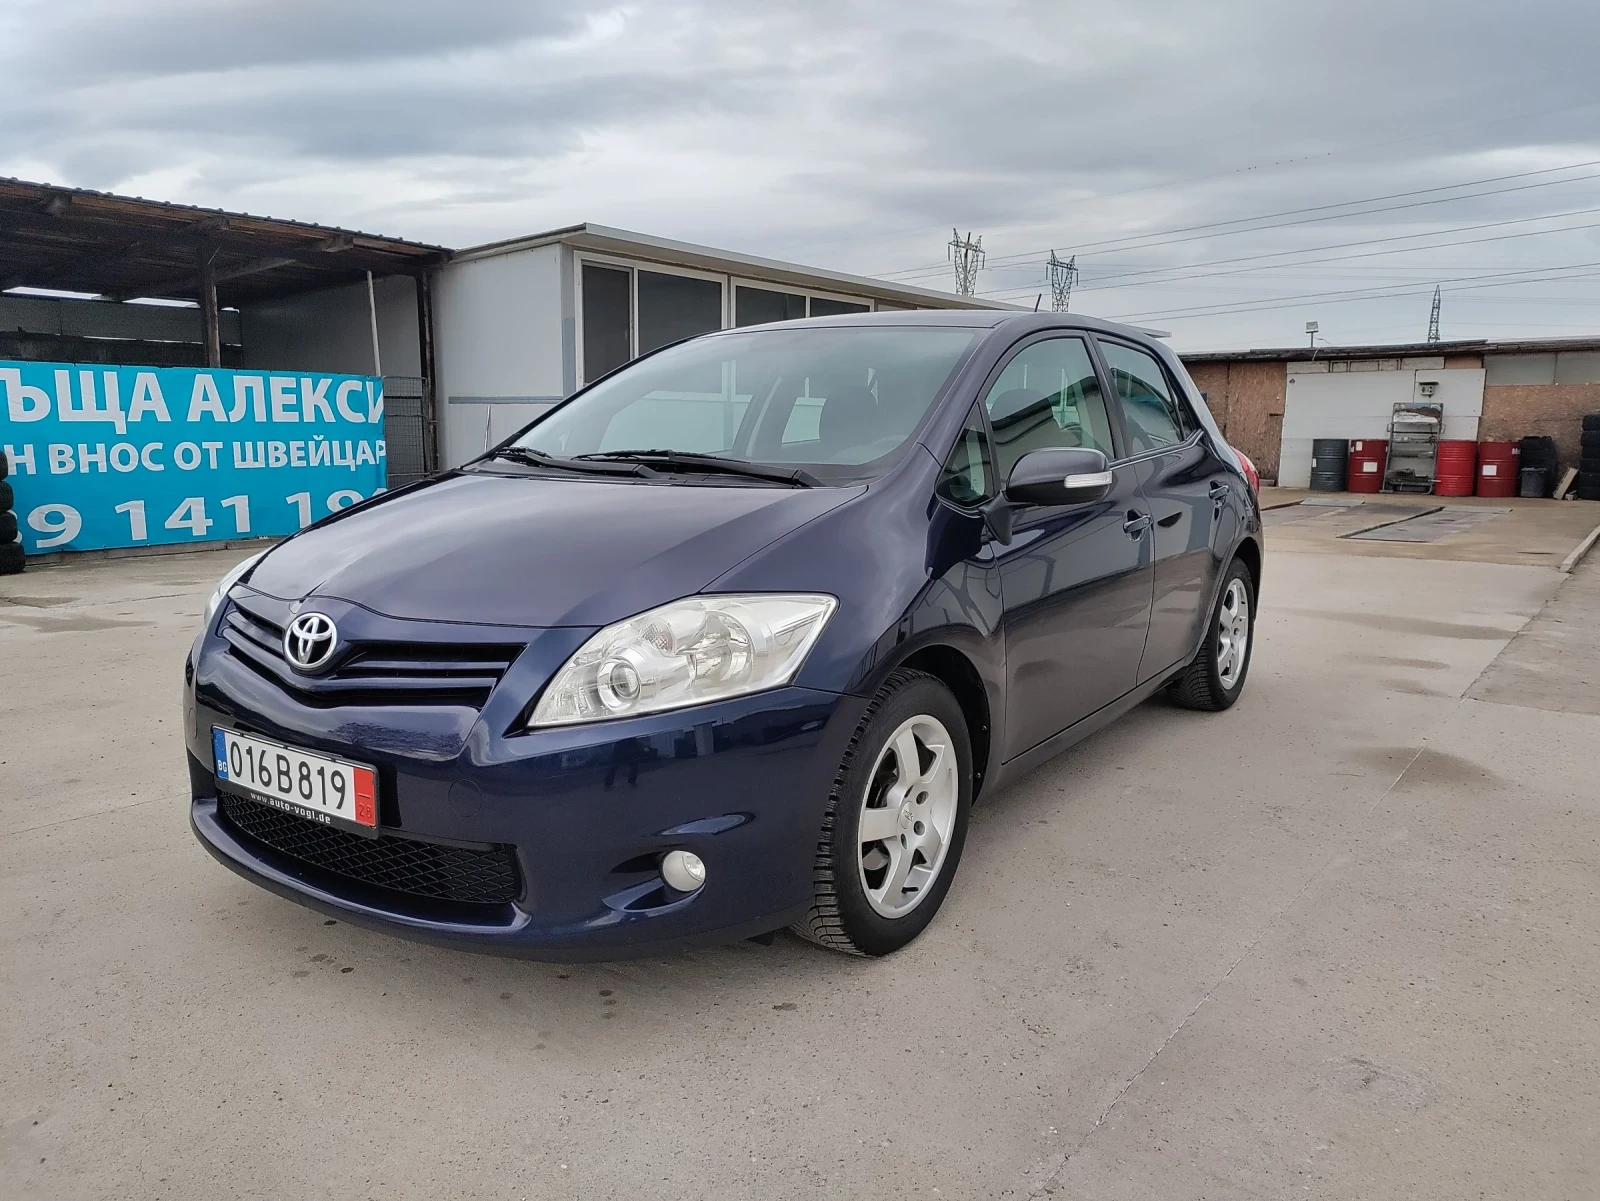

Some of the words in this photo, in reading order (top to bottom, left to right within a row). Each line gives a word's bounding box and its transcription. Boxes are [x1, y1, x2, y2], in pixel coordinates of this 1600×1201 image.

[48, 441, 165, 475] ВНОС
[174, 441, 223, 470] ОТ
[115, 495, 251, 541] 141
[217, 759, 228, 773] BG
[230, 740, 346, 810] 016B819
[250, 792, 331, 825] www.auto-vogl.de
